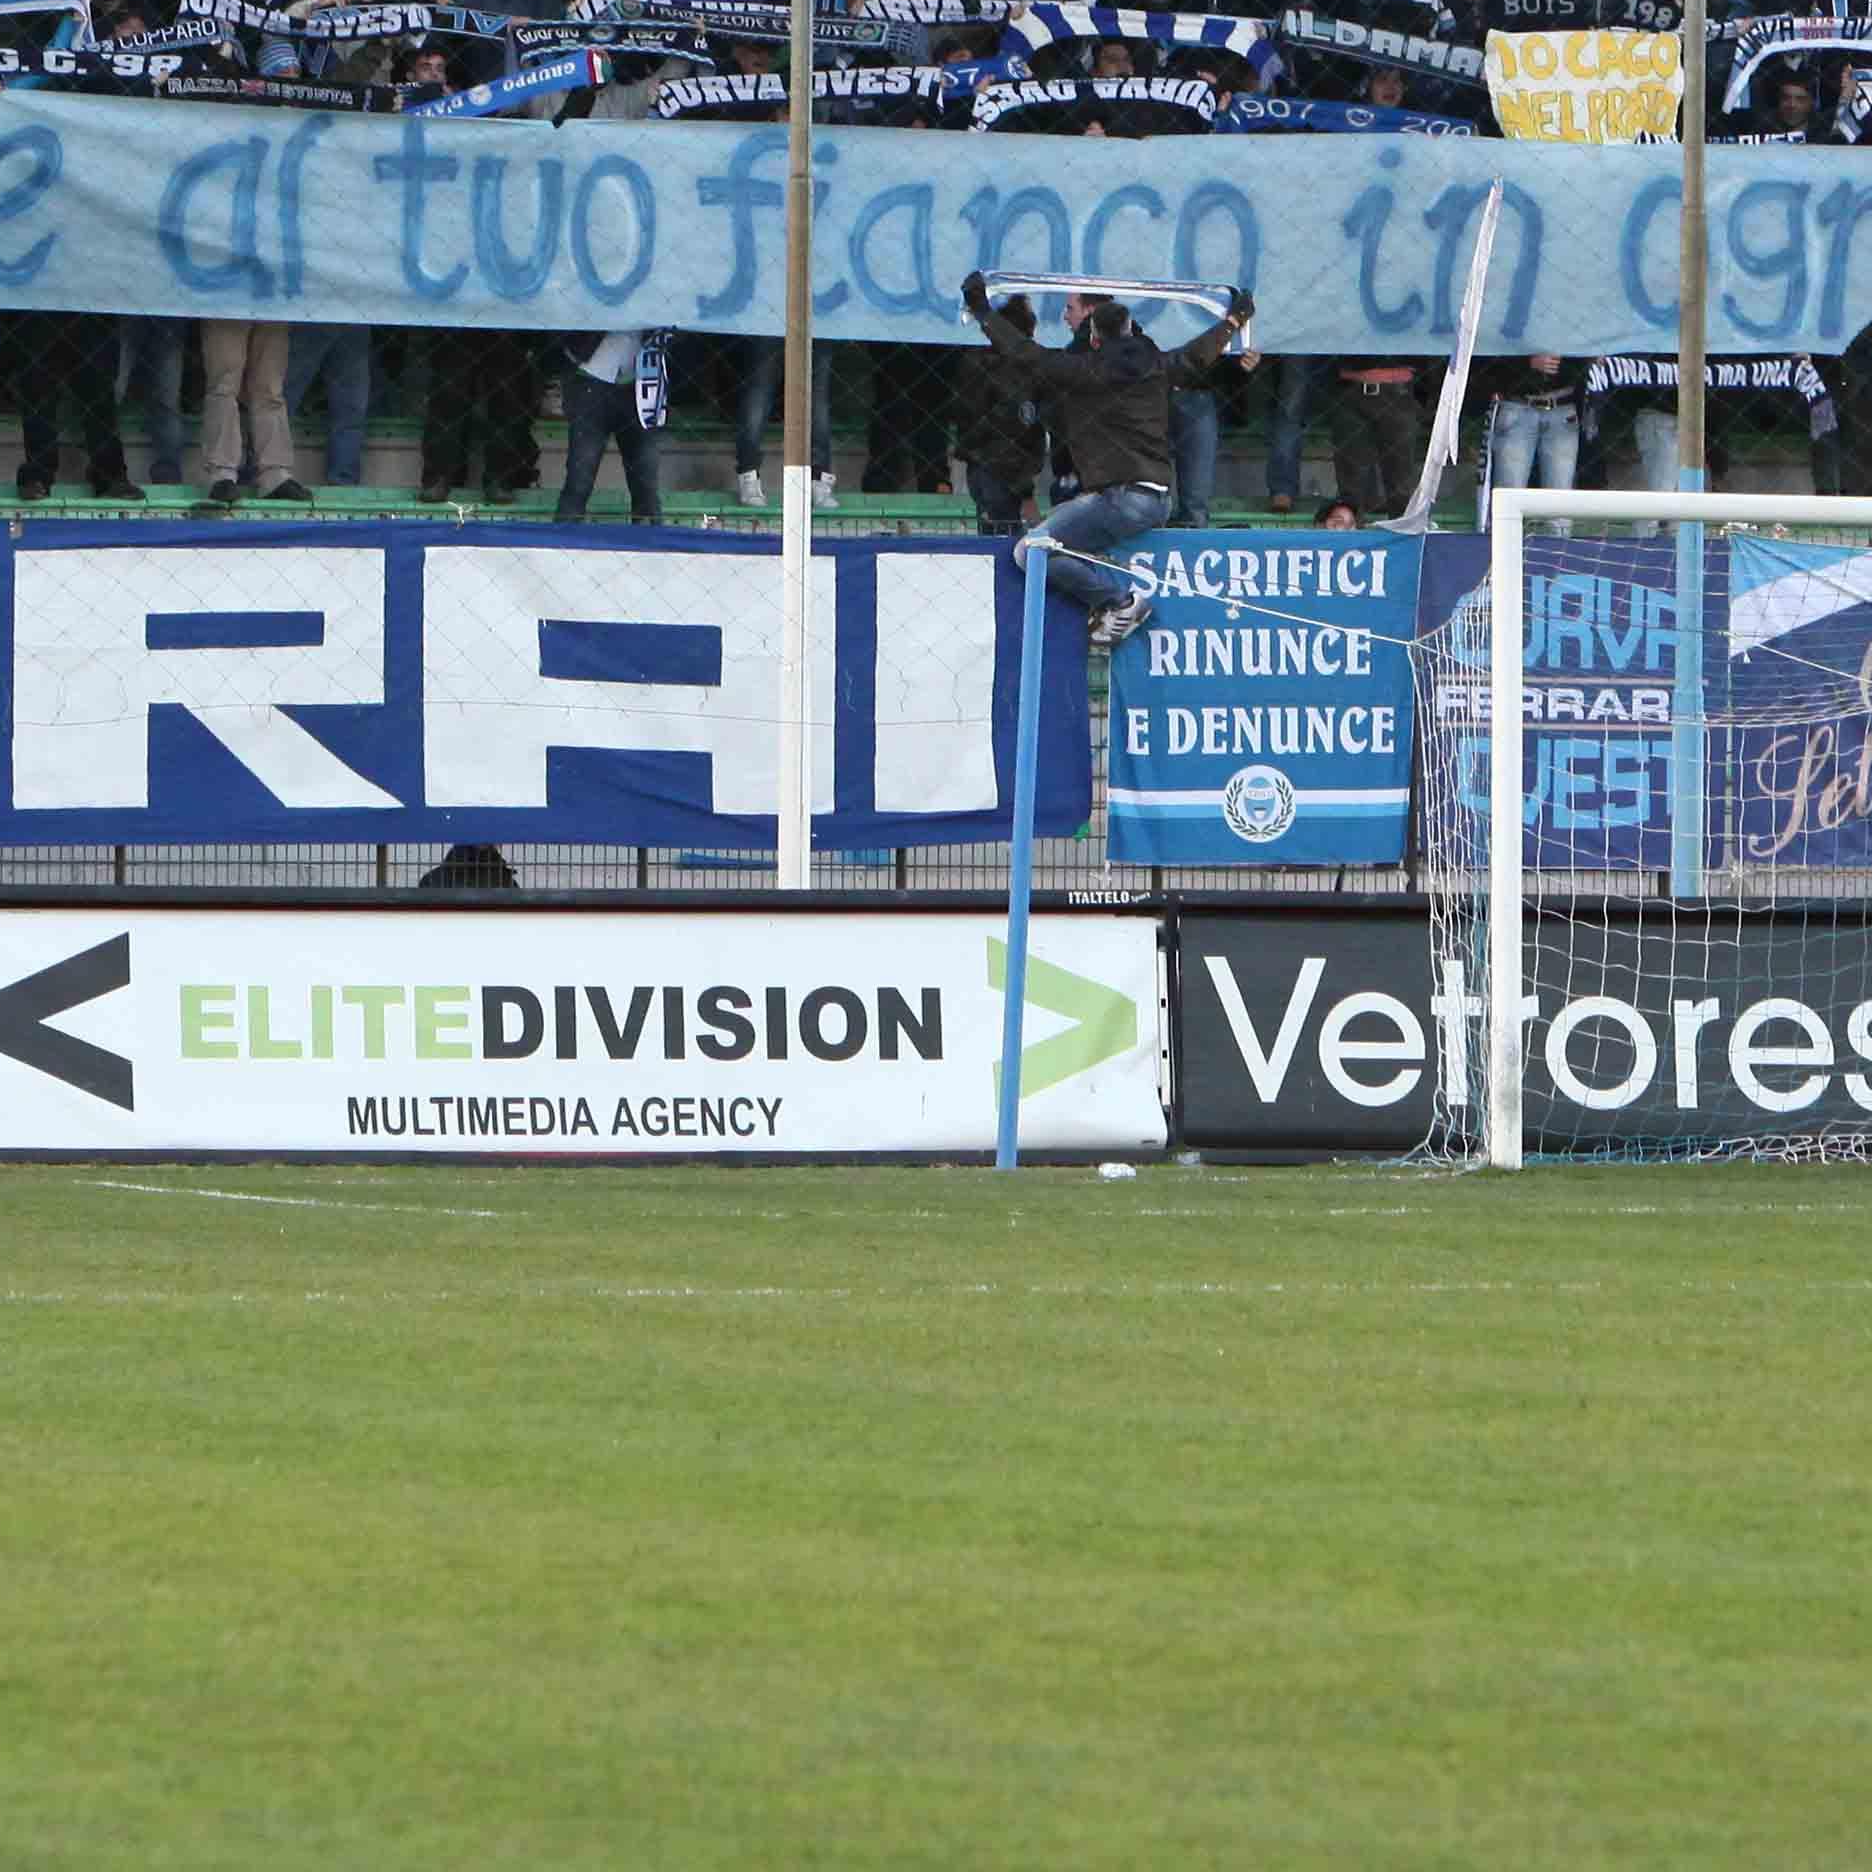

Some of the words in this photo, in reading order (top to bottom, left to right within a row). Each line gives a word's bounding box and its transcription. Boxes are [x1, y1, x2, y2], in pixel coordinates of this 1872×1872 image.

[500, 59, 576, 94] GRUPPO
[1564, 34, 1679, 80] CAGO
[655, 71, 786, 118] CURVA
[158, 125, 332, 302] al
[373, 146, 655, 314] tuo
[695, 140, 1262, 324] fianco
[1340, 146, 1548, 342] in
[1750, 359, 1795, 388] UNA
[1128, 548, 1388, 601] SACRIFICI
[1147, 626, 1373, 679] RINUNCE
[1125, 708, 1151, 757] E
[1166, 704, 1397, 758] DENUNCE
[1068, 891, 1130, 906] ITALTELO
[178, 984, 945, 1064] ELITEDIVISION
[346, 1096, 599, 1139] MULTIMEDIA
[610, 1095, 785, 1138] AGENCY
